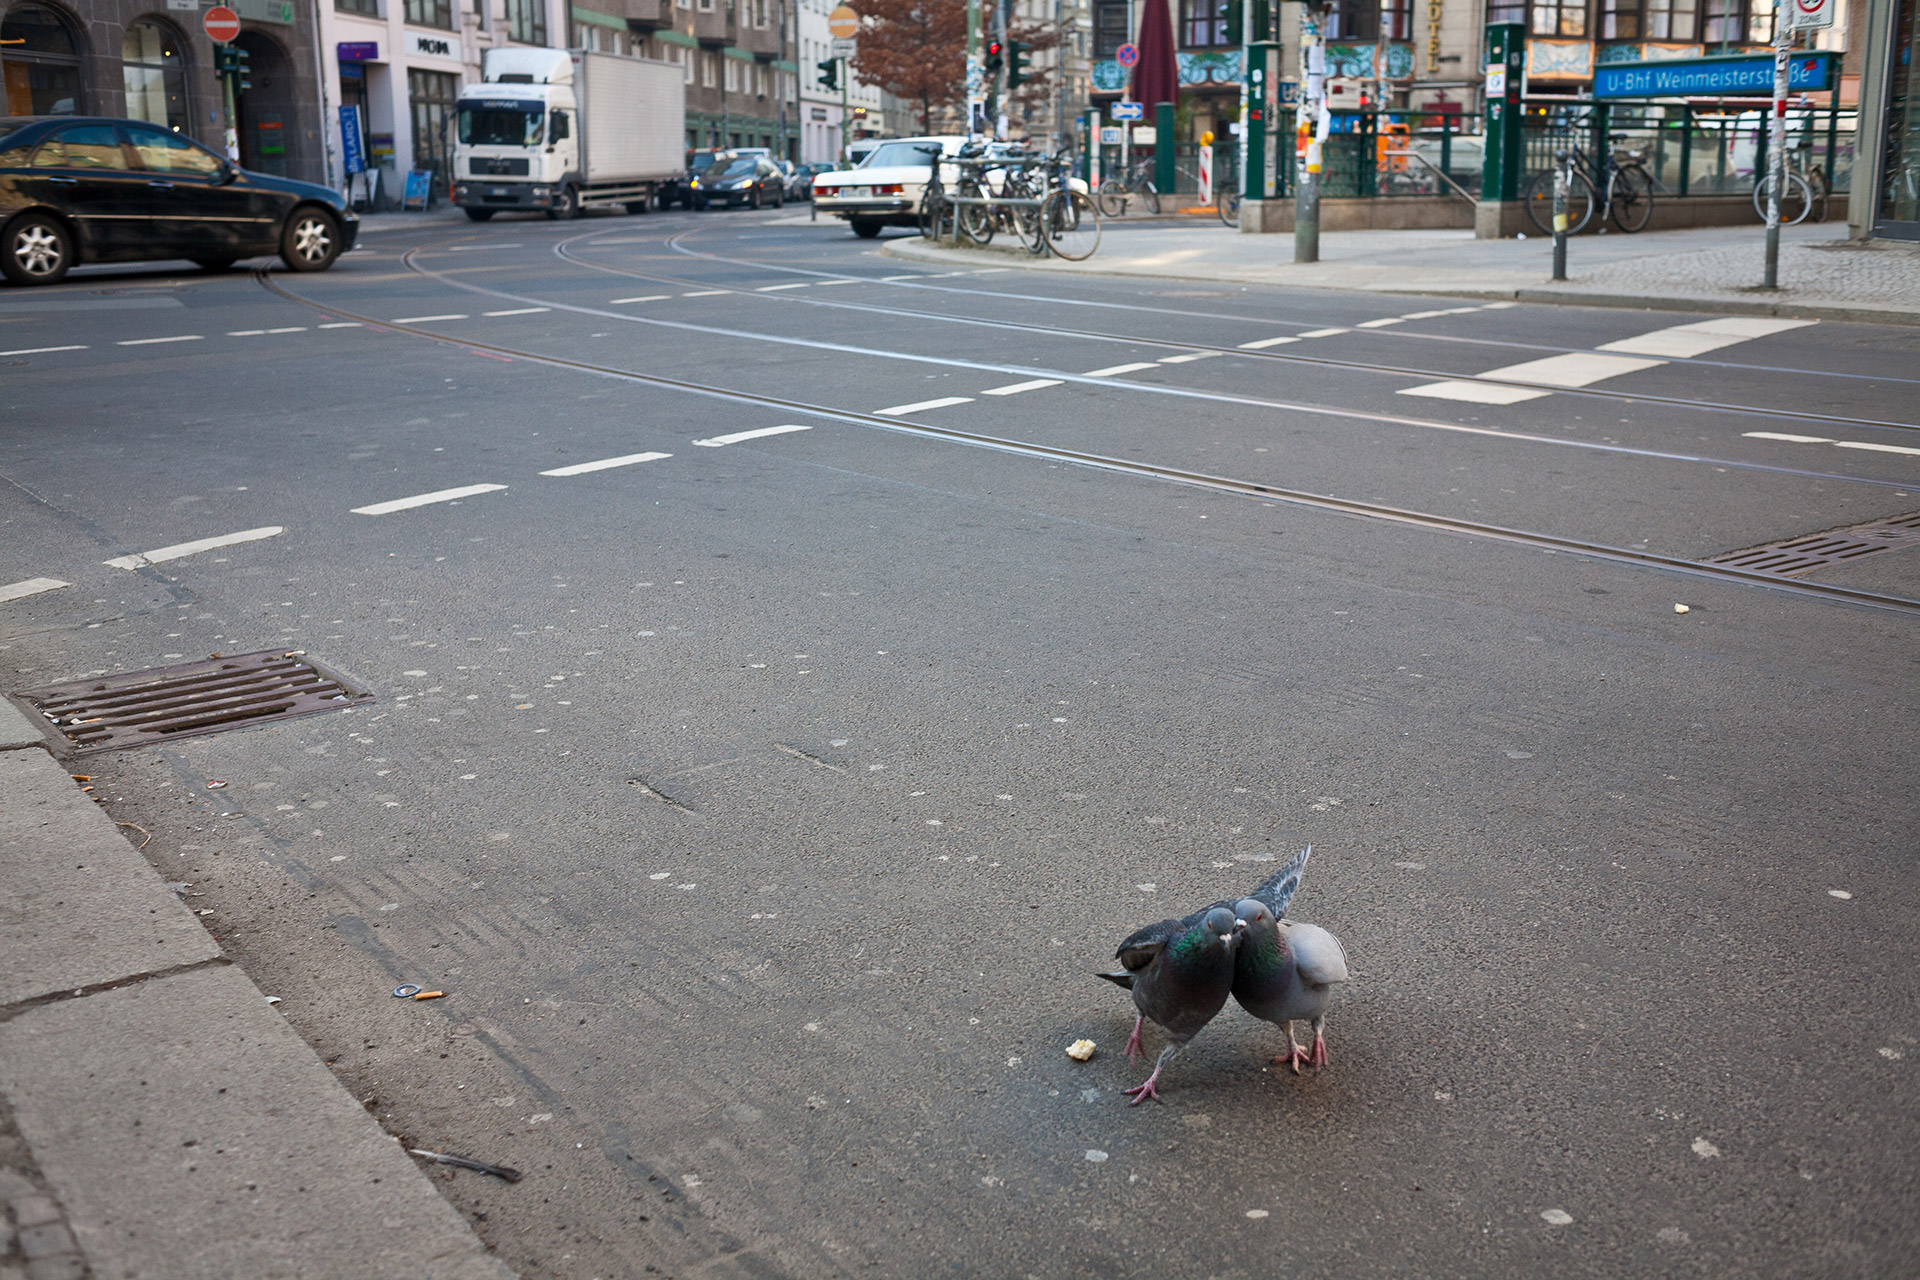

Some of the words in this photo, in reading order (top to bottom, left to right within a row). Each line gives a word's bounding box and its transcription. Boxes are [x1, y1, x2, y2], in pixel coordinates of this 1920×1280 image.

[1799, 14, 1822, 24] ZONE
[1427, 0, 1441, 71] OTEL
[1607, 71, 1651, 91] U-Bhf
[1656, 62, 1811, 89] Weinmeisterstße
